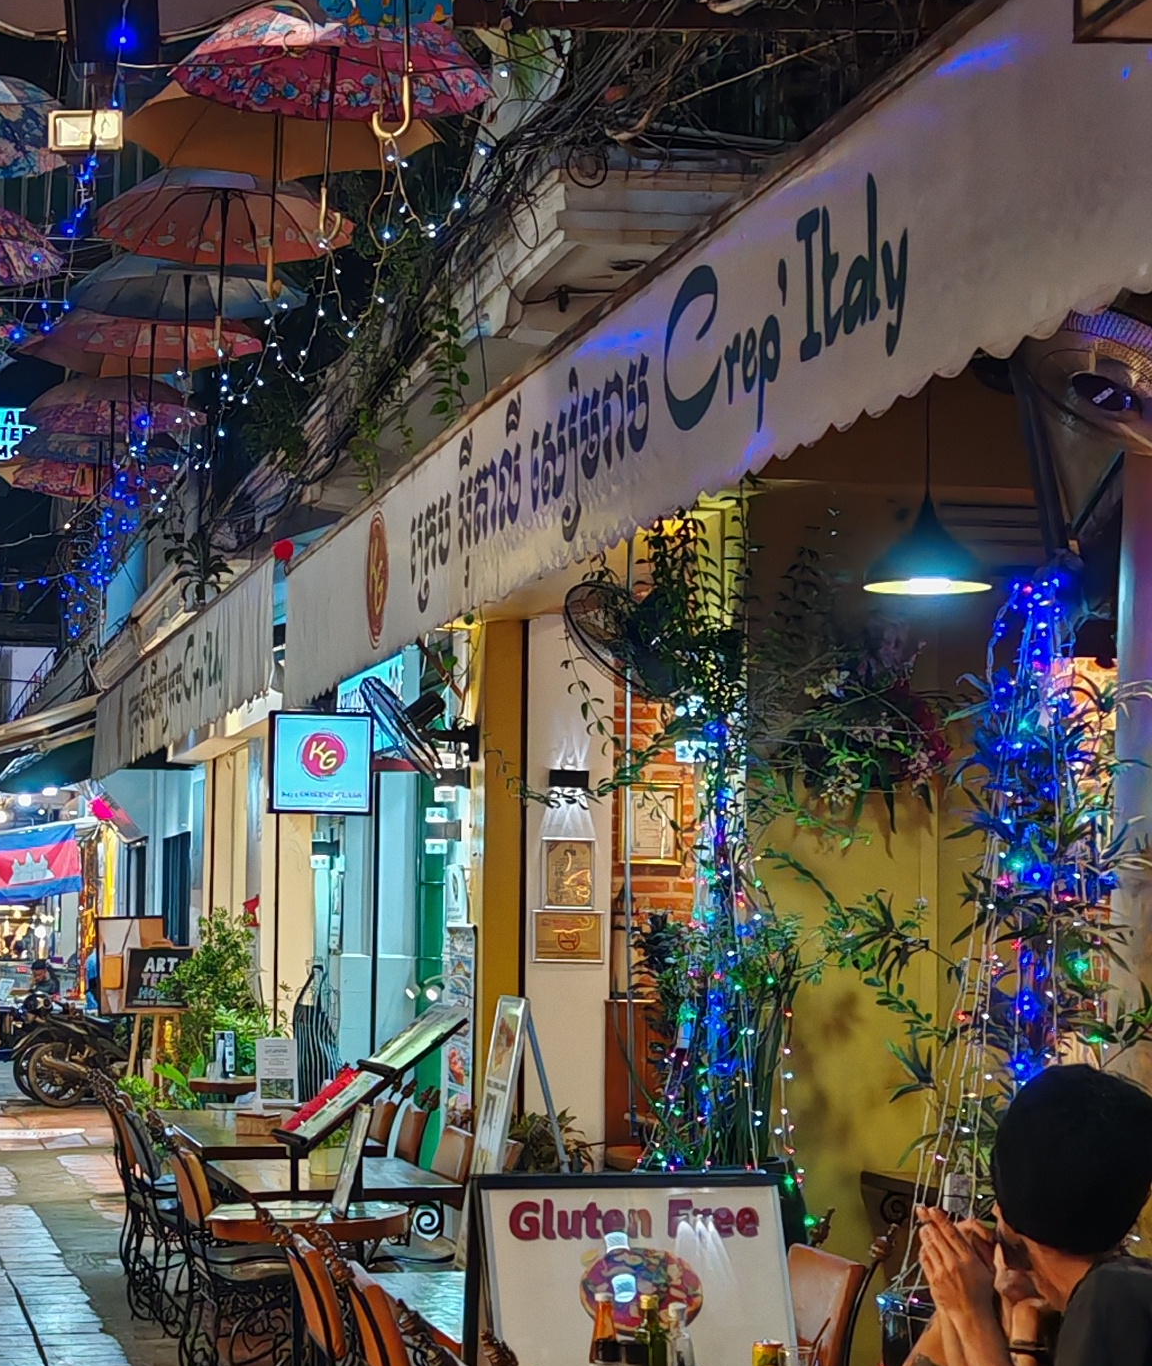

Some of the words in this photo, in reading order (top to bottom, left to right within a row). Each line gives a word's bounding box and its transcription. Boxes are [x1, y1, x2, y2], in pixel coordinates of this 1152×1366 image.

[309, 740, 338, 770] KG
[143, 956, 178, 972] ART
[137, 986, 176, 1000] MOR
[509, 1198, 652, 1241] Gluten
